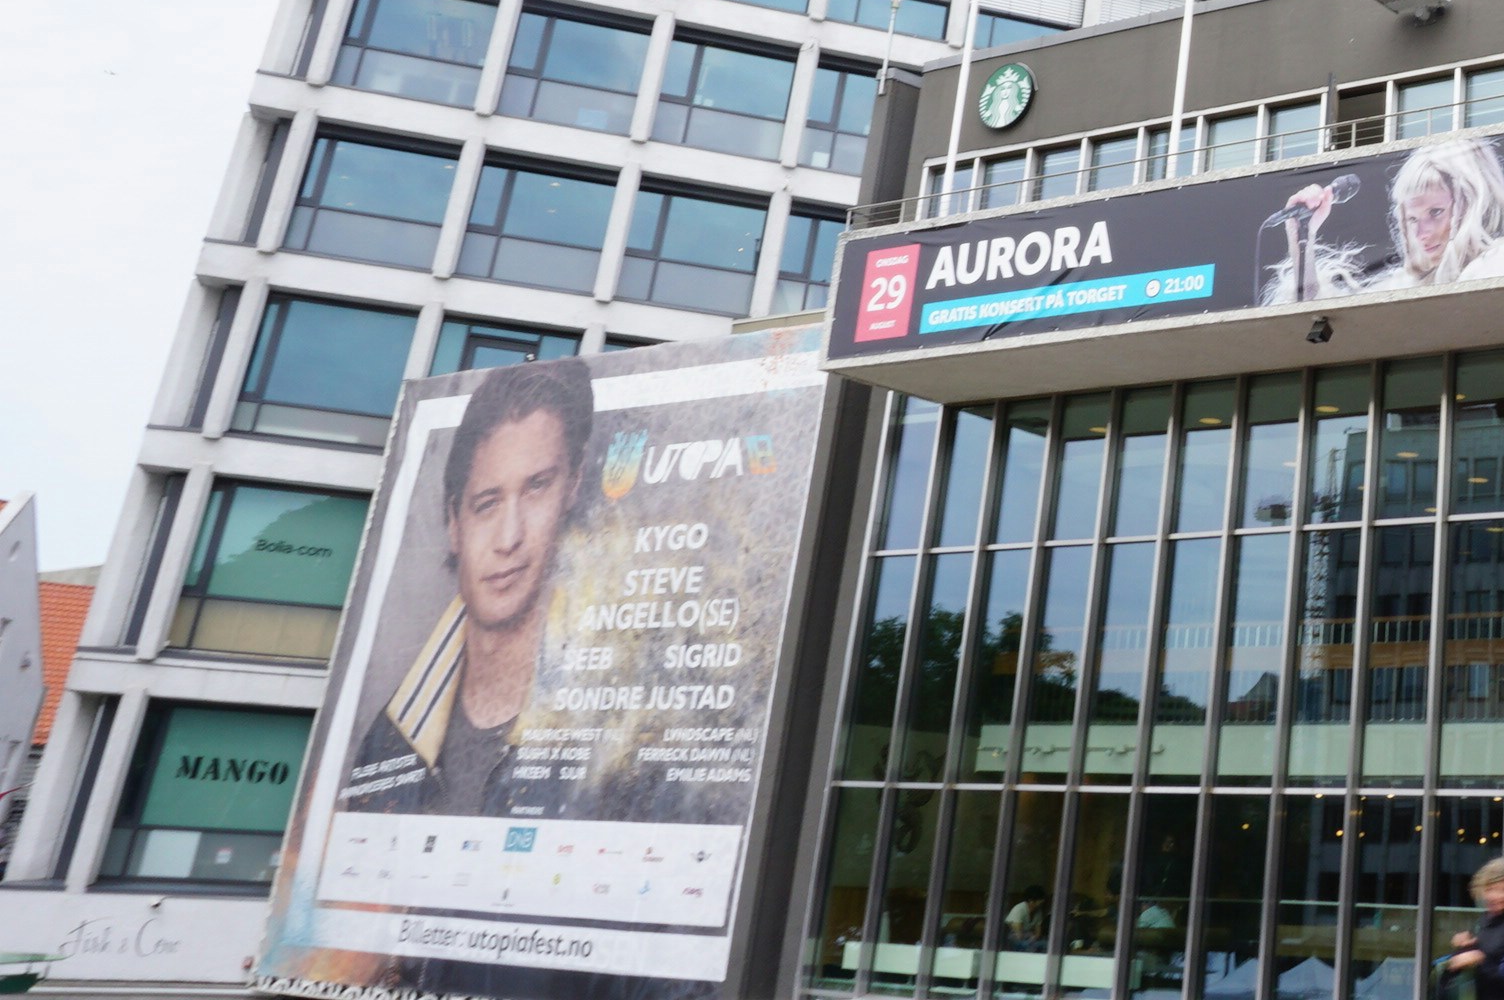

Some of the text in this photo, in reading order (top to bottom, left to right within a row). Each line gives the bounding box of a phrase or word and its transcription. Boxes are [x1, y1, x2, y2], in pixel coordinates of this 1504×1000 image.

[925, 220, 1113, 290] AURORA
[866, 274, 907, 313] 29
[1163, 273, 1206, 295] 21:00
[928, 284, 1127, 326] GRATIS KONSERT PÅ TORGET
[633, 522, 709, 554] KYGO
[623, 566, 704, 597] STEVE
[562, 643, 743, 672] SEEB SIGRID
[552, 684, 736, 711] SONDRE JUSTAD
[175, 755, 290, 786] MANGO
[689, 748, 732, 762] DAWN
[468, 928, 594, 960] utopiafest.no
